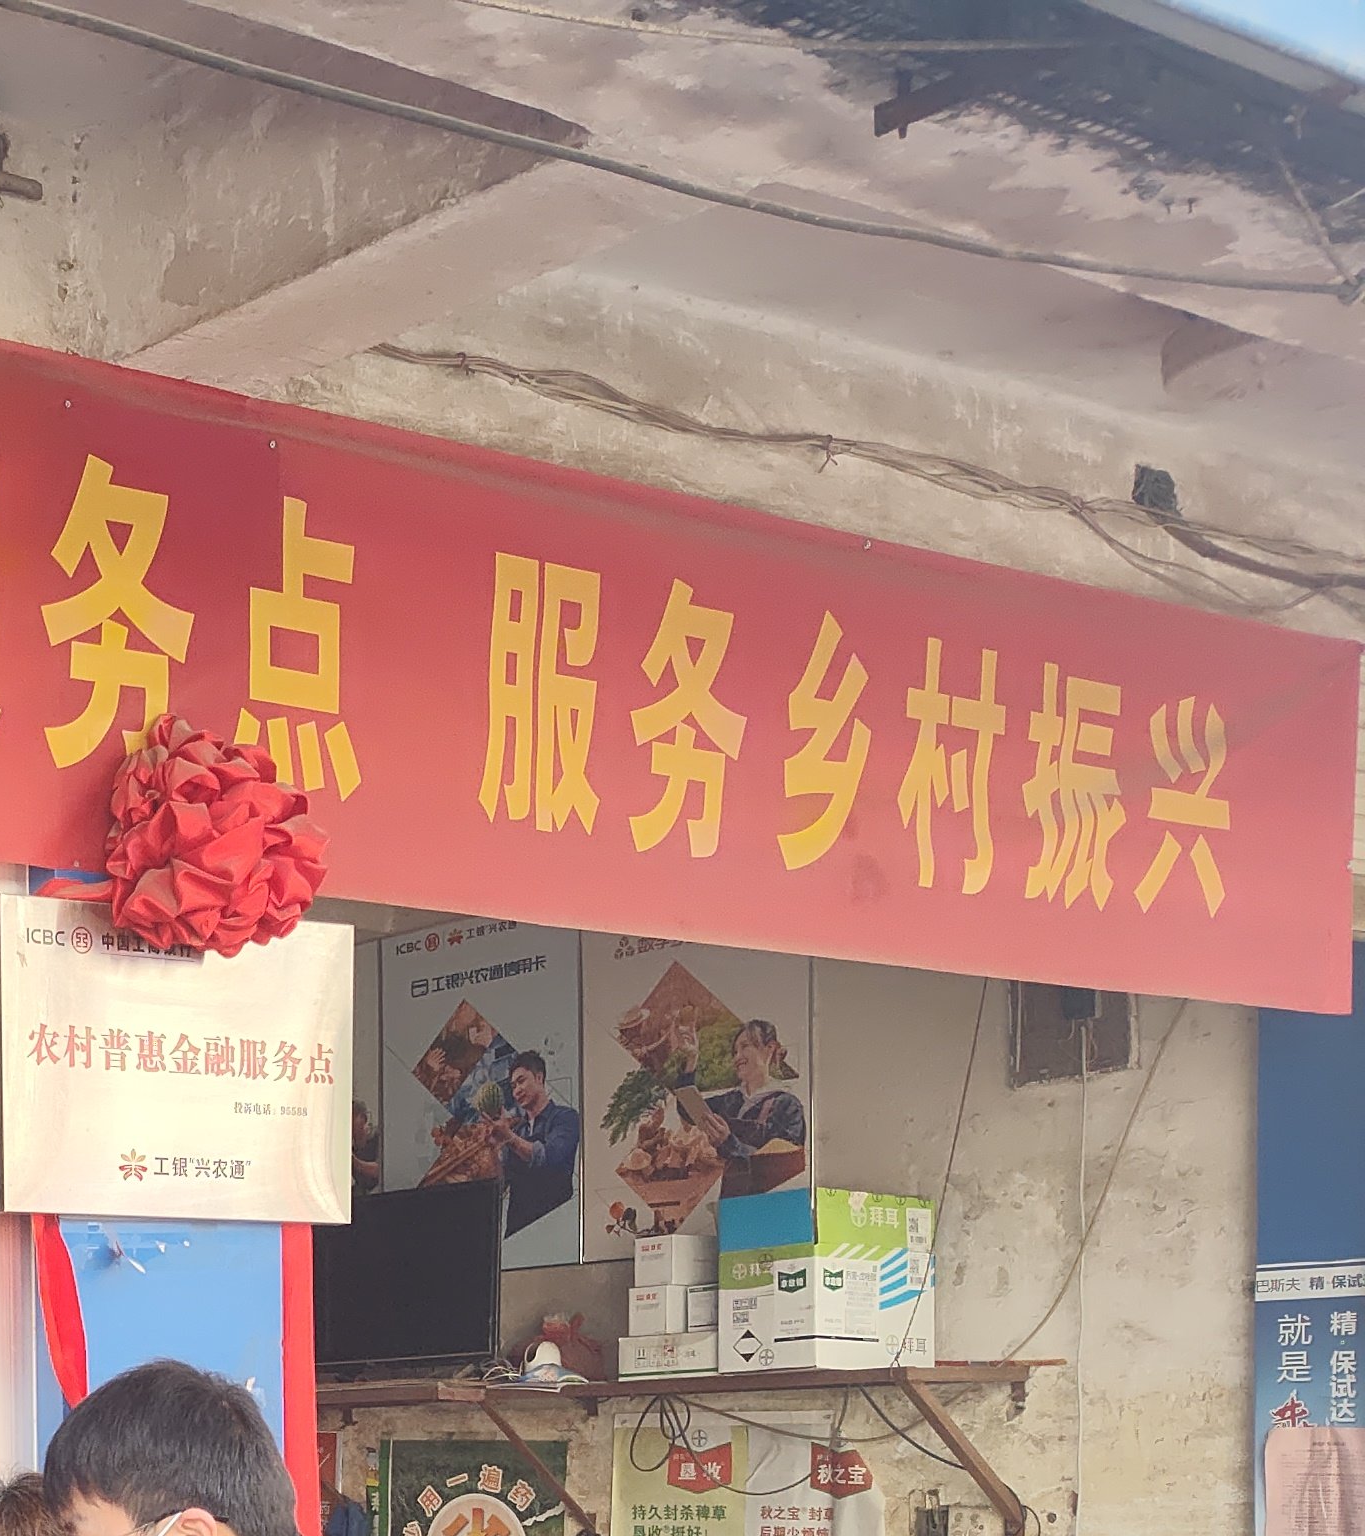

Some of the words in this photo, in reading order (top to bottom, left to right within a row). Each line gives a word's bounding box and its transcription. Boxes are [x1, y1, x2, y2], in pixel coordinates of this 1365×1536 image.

[479, 552, 1235, 918] 服务乡村振兴
[26, 927, 66, 947] ICBC
[396, 941, 422, 956] ICBC
[431, 955, 548, 993] 工银兴农通信用卡
[27, 1022, 336, 1086] 农村普惠金融服务点
[1256, 1278, 1302, 1293] 巴斯夫
[817, 1463, 868, 1486] 秋之宝
[631, 1504, 728, 1522] 持久封杀稗草
